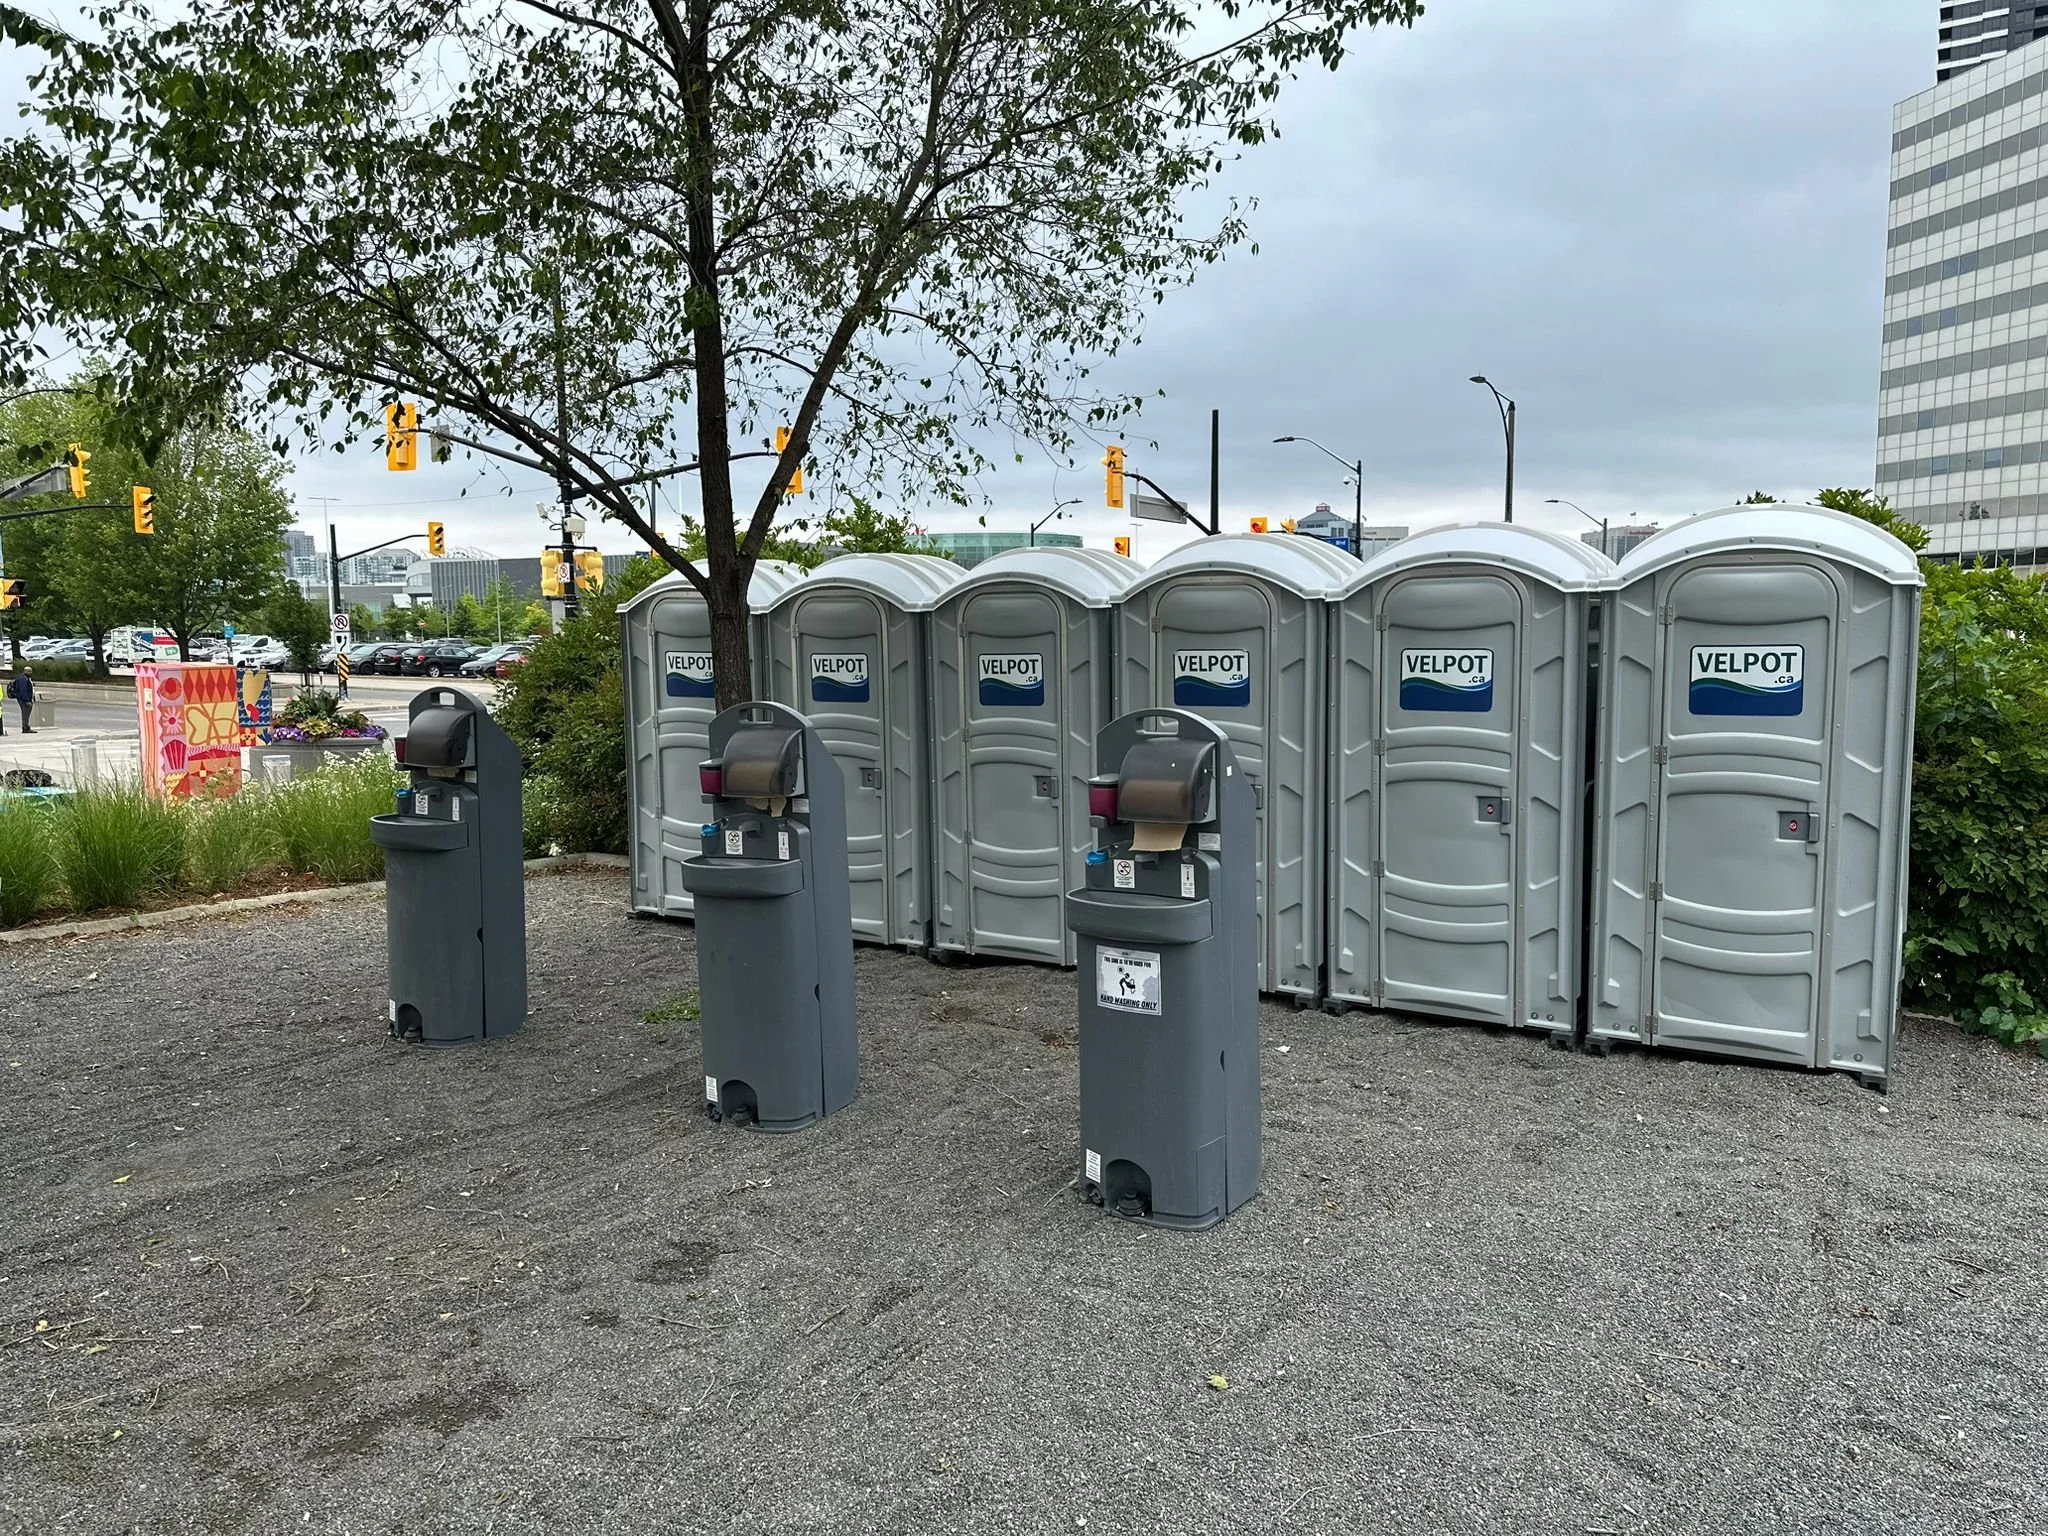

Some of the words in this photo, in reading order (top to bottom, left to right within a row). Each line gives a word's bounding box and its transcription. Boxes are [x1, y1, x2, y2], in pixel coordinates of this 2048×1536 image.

[668, 655, 713, 670] VELPOT
[813, 658, 864, 673] VELPOT
[982, 659, 1039, 674] VELPOT
[1178, 655, 1245, 672] VELPOT
[1407, 655, 1488, 673] VELPOT
[1697, 652, 1797, 673] VELPOT
[1468, 675, 1486, 683] .ca
[1774, 675, 1794, 684] .ca
[1101, 994, 1114, 1002] HAND
[1114, 997, 1140, 1007] WASHING
[1141, 1000, 1158, 1009] ONLY
